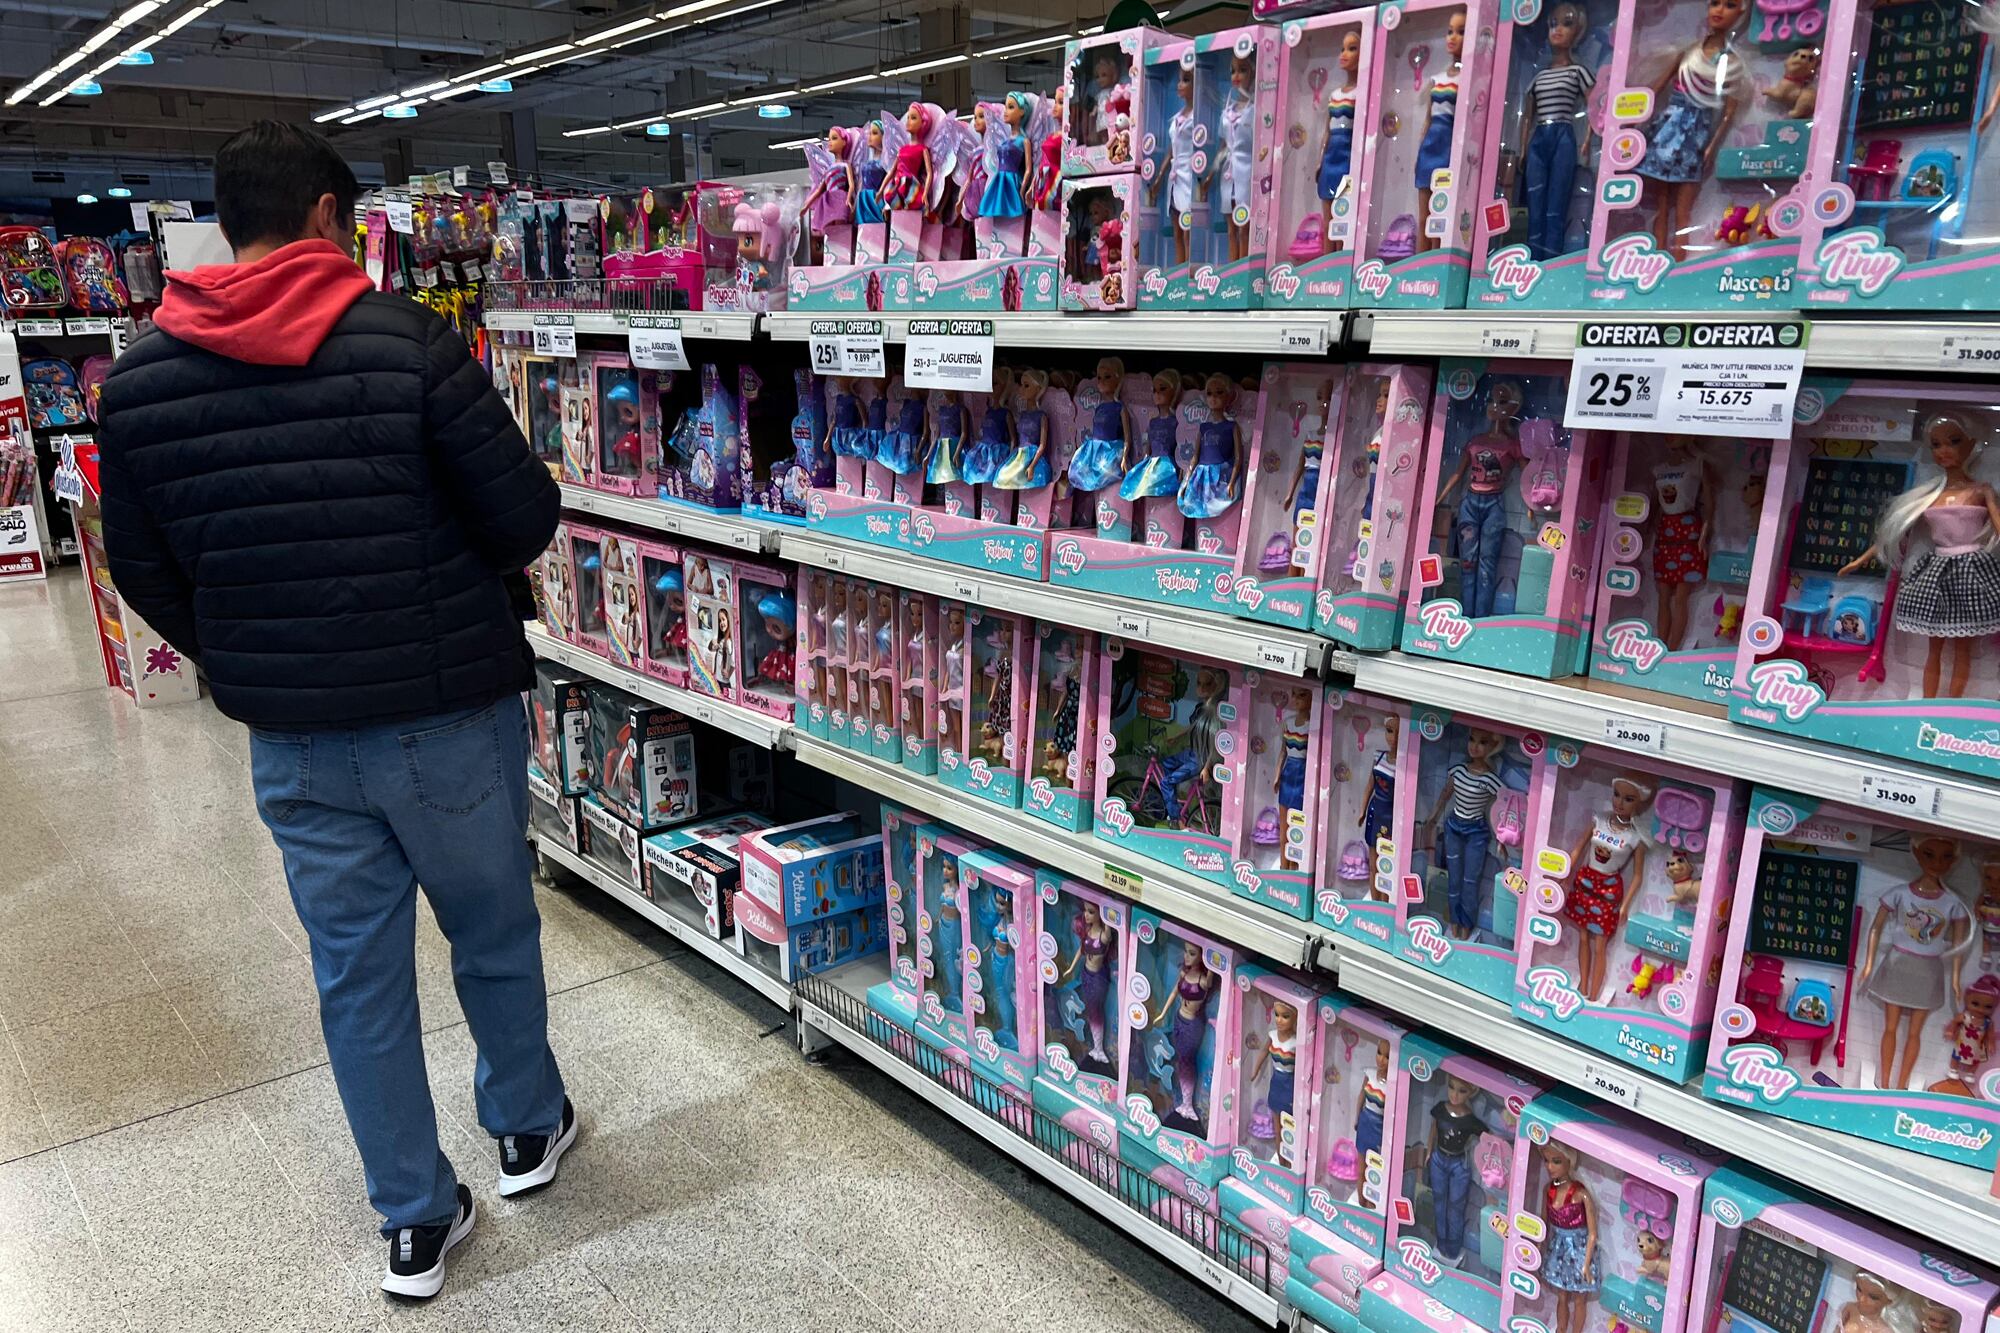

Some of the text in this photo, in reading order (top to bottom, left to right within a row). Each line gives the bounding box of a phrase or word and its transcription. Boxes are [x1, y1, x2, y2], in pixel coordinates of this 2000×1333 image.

[1489, 249, 1541, 290] Tiny
[1602, 236, 1670, 289] Tiny
[1820, 237, 1902, 292] Tiny
[790, 269, 809, 297] Tiny
[917, 268, 939, 296] Tiny
[1145, 269, 1167, 295] Tiny
[1196, 266, 1220, 295] Tiny
[1270, 264, 1300, 297] Tiny
[1357, 262, 1390, 296] Tiny
[709, 284, 738, 306] Pinypon
[534, 316, 569, 325] OFERTA OFERTA
[630, 317, 649, 327] OFERTA
[655, 317, 674, 328] OFERTA
[812, 322, 873, 333] OFERTA OFERTA
[910, 321, 982, 334] OFERTA OFERTA
[1289, 337, 1311, 345] 12.700
[1492, 338, 1520, 348] 19.899
[1585, 325, 1774, 346] OFERTA OFERTA
[939, 351, 983, 365] JUGUETERÍA
[0, 407, 19, 417] AYOR
[1636, 394, 1651, 402] DTO
[1677, 390, 1753, 406] $ 15.675
[811, 495, 827, 519] Tiny
[915, 515, 935, 544] Tiny
[1058, 543, 1085, 573] Tiny
[1156, 569, 1198, 592] Fashion
[1218, 580, 1229, 589] 09
[1234, 578, 1263, 611] Tiny
[1317, 591, 1333, 622] Tiny
[1420, 601, 1472, 648] Tiny
[1264, 653, 1285, 664] 12.700
[1604, 621, 1667, 670] Tiny
[1705, 669, 1734, 688] Masc
[1751, 661, 1822, 718] Tiny
[1617, 730, 1650, 743] 20.900
[970, 761, 992, 786] Tiny
[1031, 779, 1054, 809] Tiny
[1876, 789, 1917, 805] 31.900
[1104, 799, 1132, 837] Tiny
[1592, 829, 1626, 845] sweet
[646, 847, 674, 869] Kitchen
[675, 863, 688, 878] Set
[1234, 861, 1261, 893] Tiny
[1111, 874, 1127, 887] 23.159
[1319, 891, 1349, 925] Tiny
[1408, 919, 1451, 962] Tiny
[898, 960, 917, 984] Tiny
[1529, 967, 1582, 1017] Tiny
[924, 993, 945, 1022] Tiny
[976, 1032, 999, 1061] Tiny
[1618, 1031, 1675, 1065] Mascota
[1047, 1043, 1076, 1080] Tiny
[1724, 1046, 1799, 1101] Tiny
[1594, 1077, 1626, 1097] 20.900
[1127, 1097, 1158, 1137] Tiny
[1913, 1123, 1981, 1149] Maestra
[1233, 1149, 1257, 1178] Tiny
[1307, 1188, 1338, 1221] Tiny
[1400, 1239, 1442, 1285] Tiny
